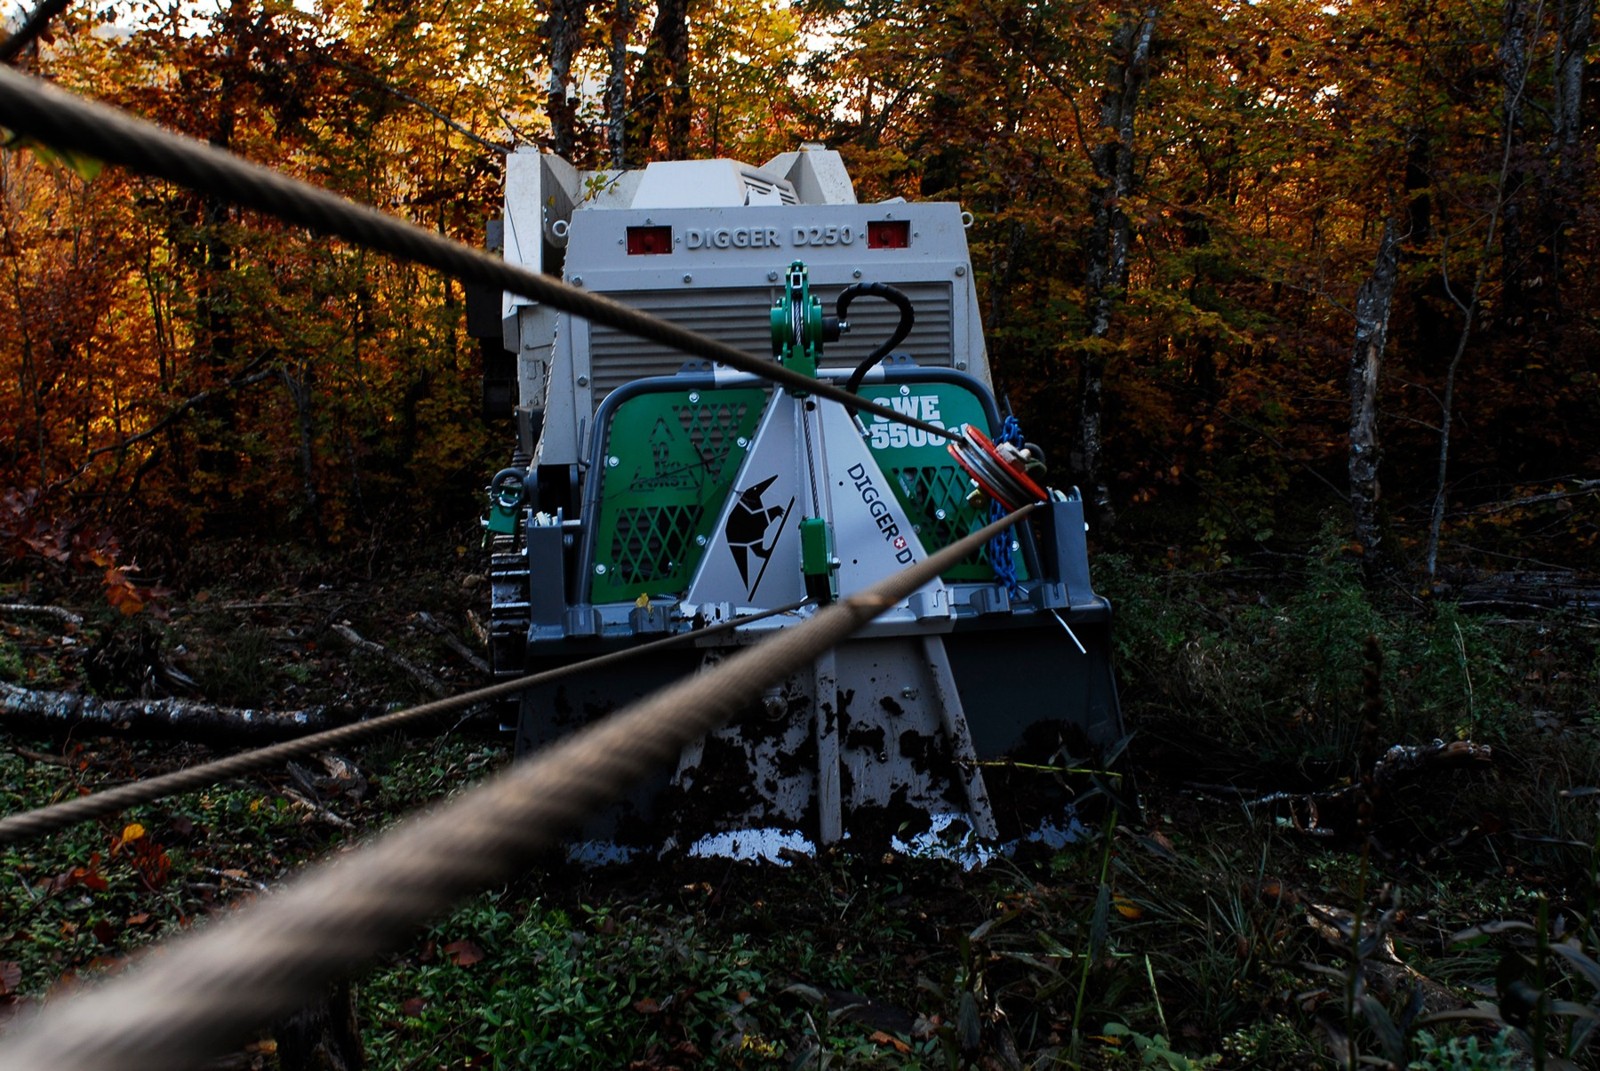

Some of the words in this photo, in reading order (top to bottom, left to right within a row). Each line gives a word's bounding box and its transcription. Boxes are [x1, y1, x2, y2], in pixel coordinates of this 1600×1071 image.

[686, 228, 780, 249] DIGGER
[792, 224, 854, 247] D250
[847, 463, 900, 541] DIGGER
[895, 547, 918, 566] D
